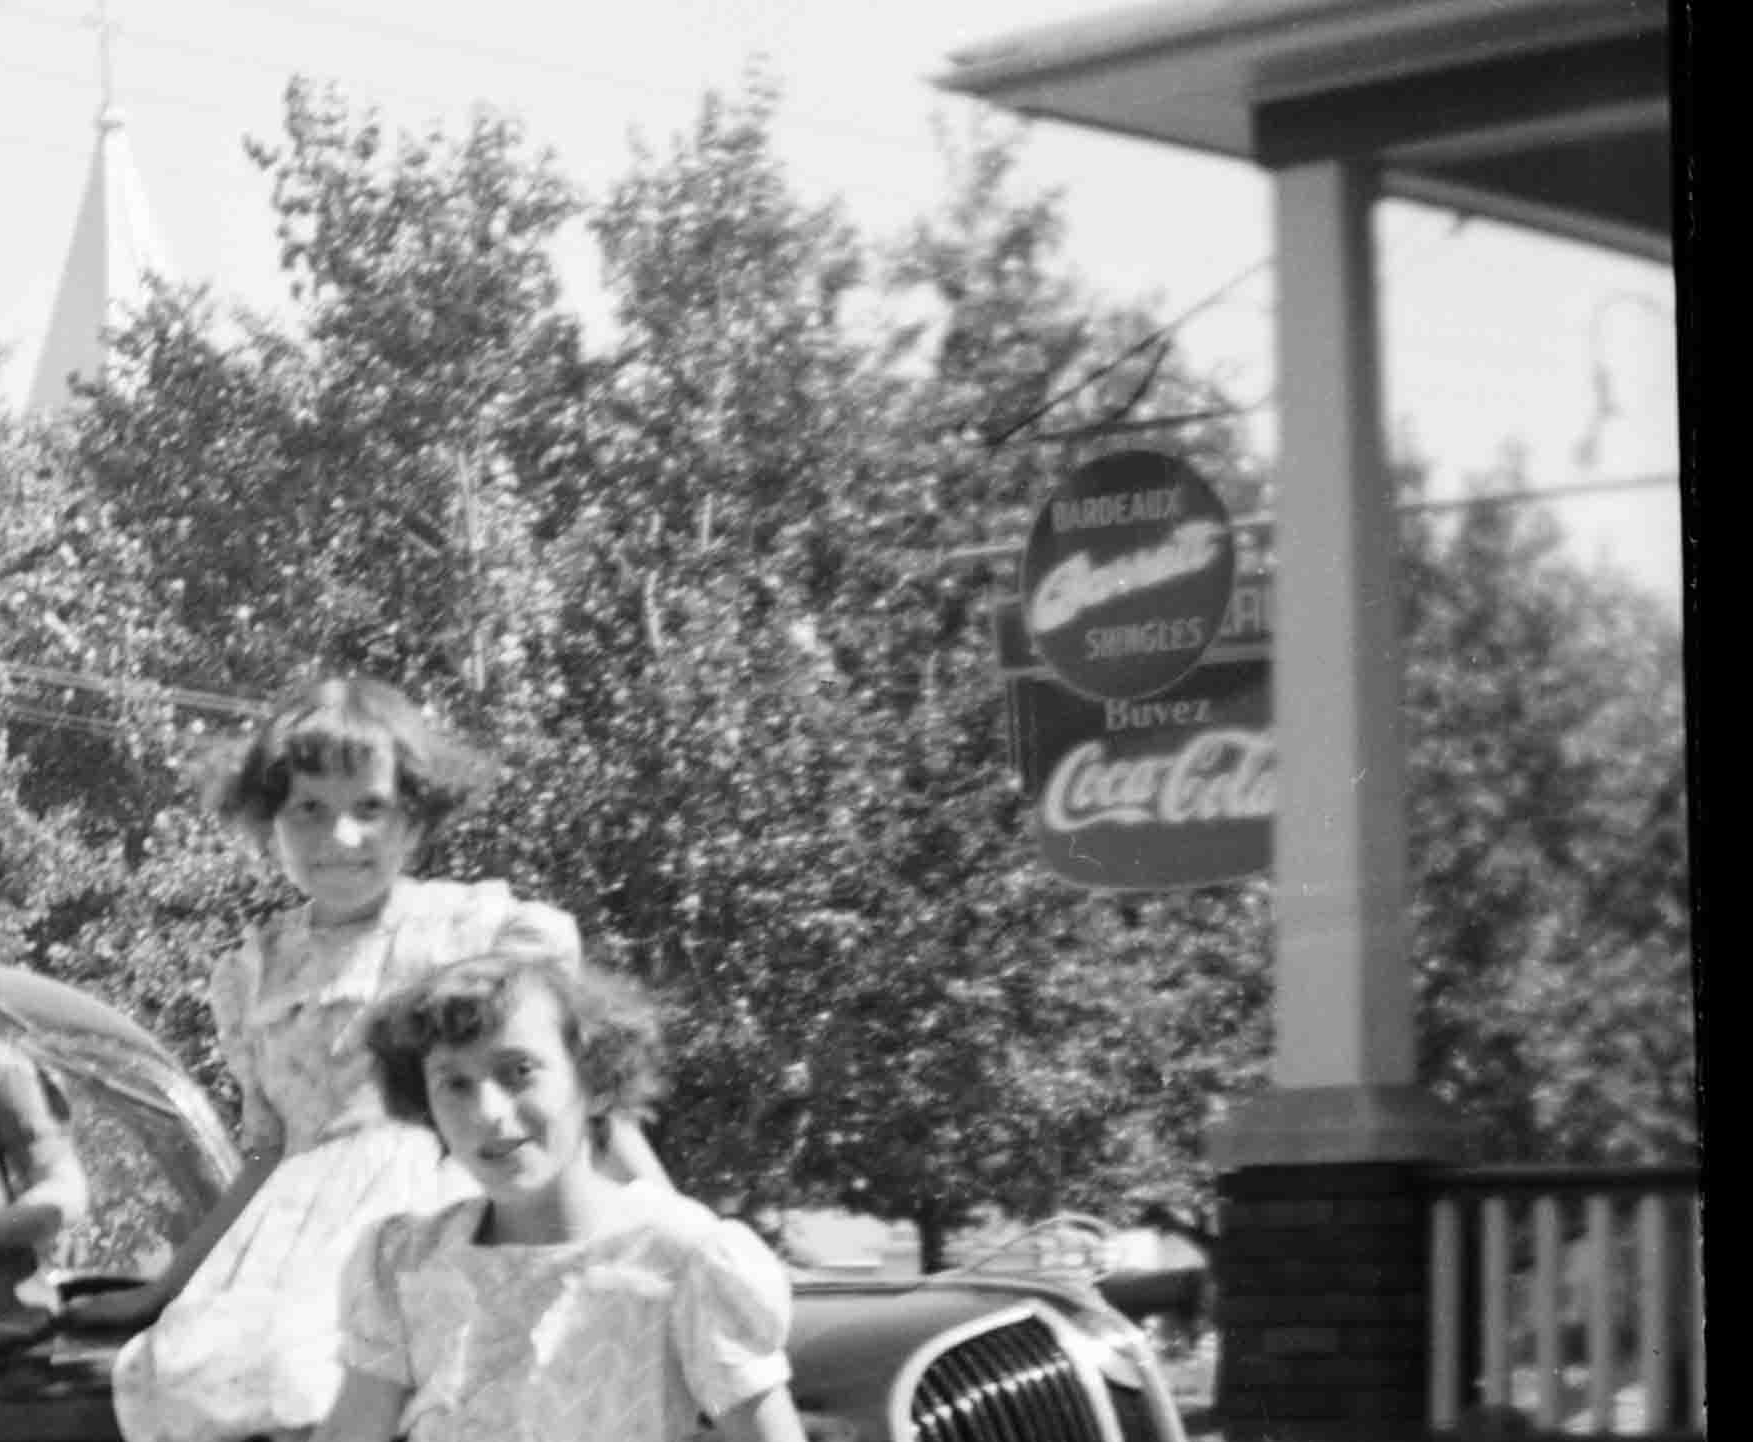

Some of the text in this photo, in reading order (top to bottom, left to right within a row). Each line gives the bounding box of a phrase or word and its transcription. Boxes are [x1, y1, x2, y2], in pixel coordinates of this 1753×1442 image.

[1051, 488, 1183, 532] BARDEAUX
[1084, 617, 1204, 659] SHINGLES
[1103, 699, 1212, 731] Buvez
